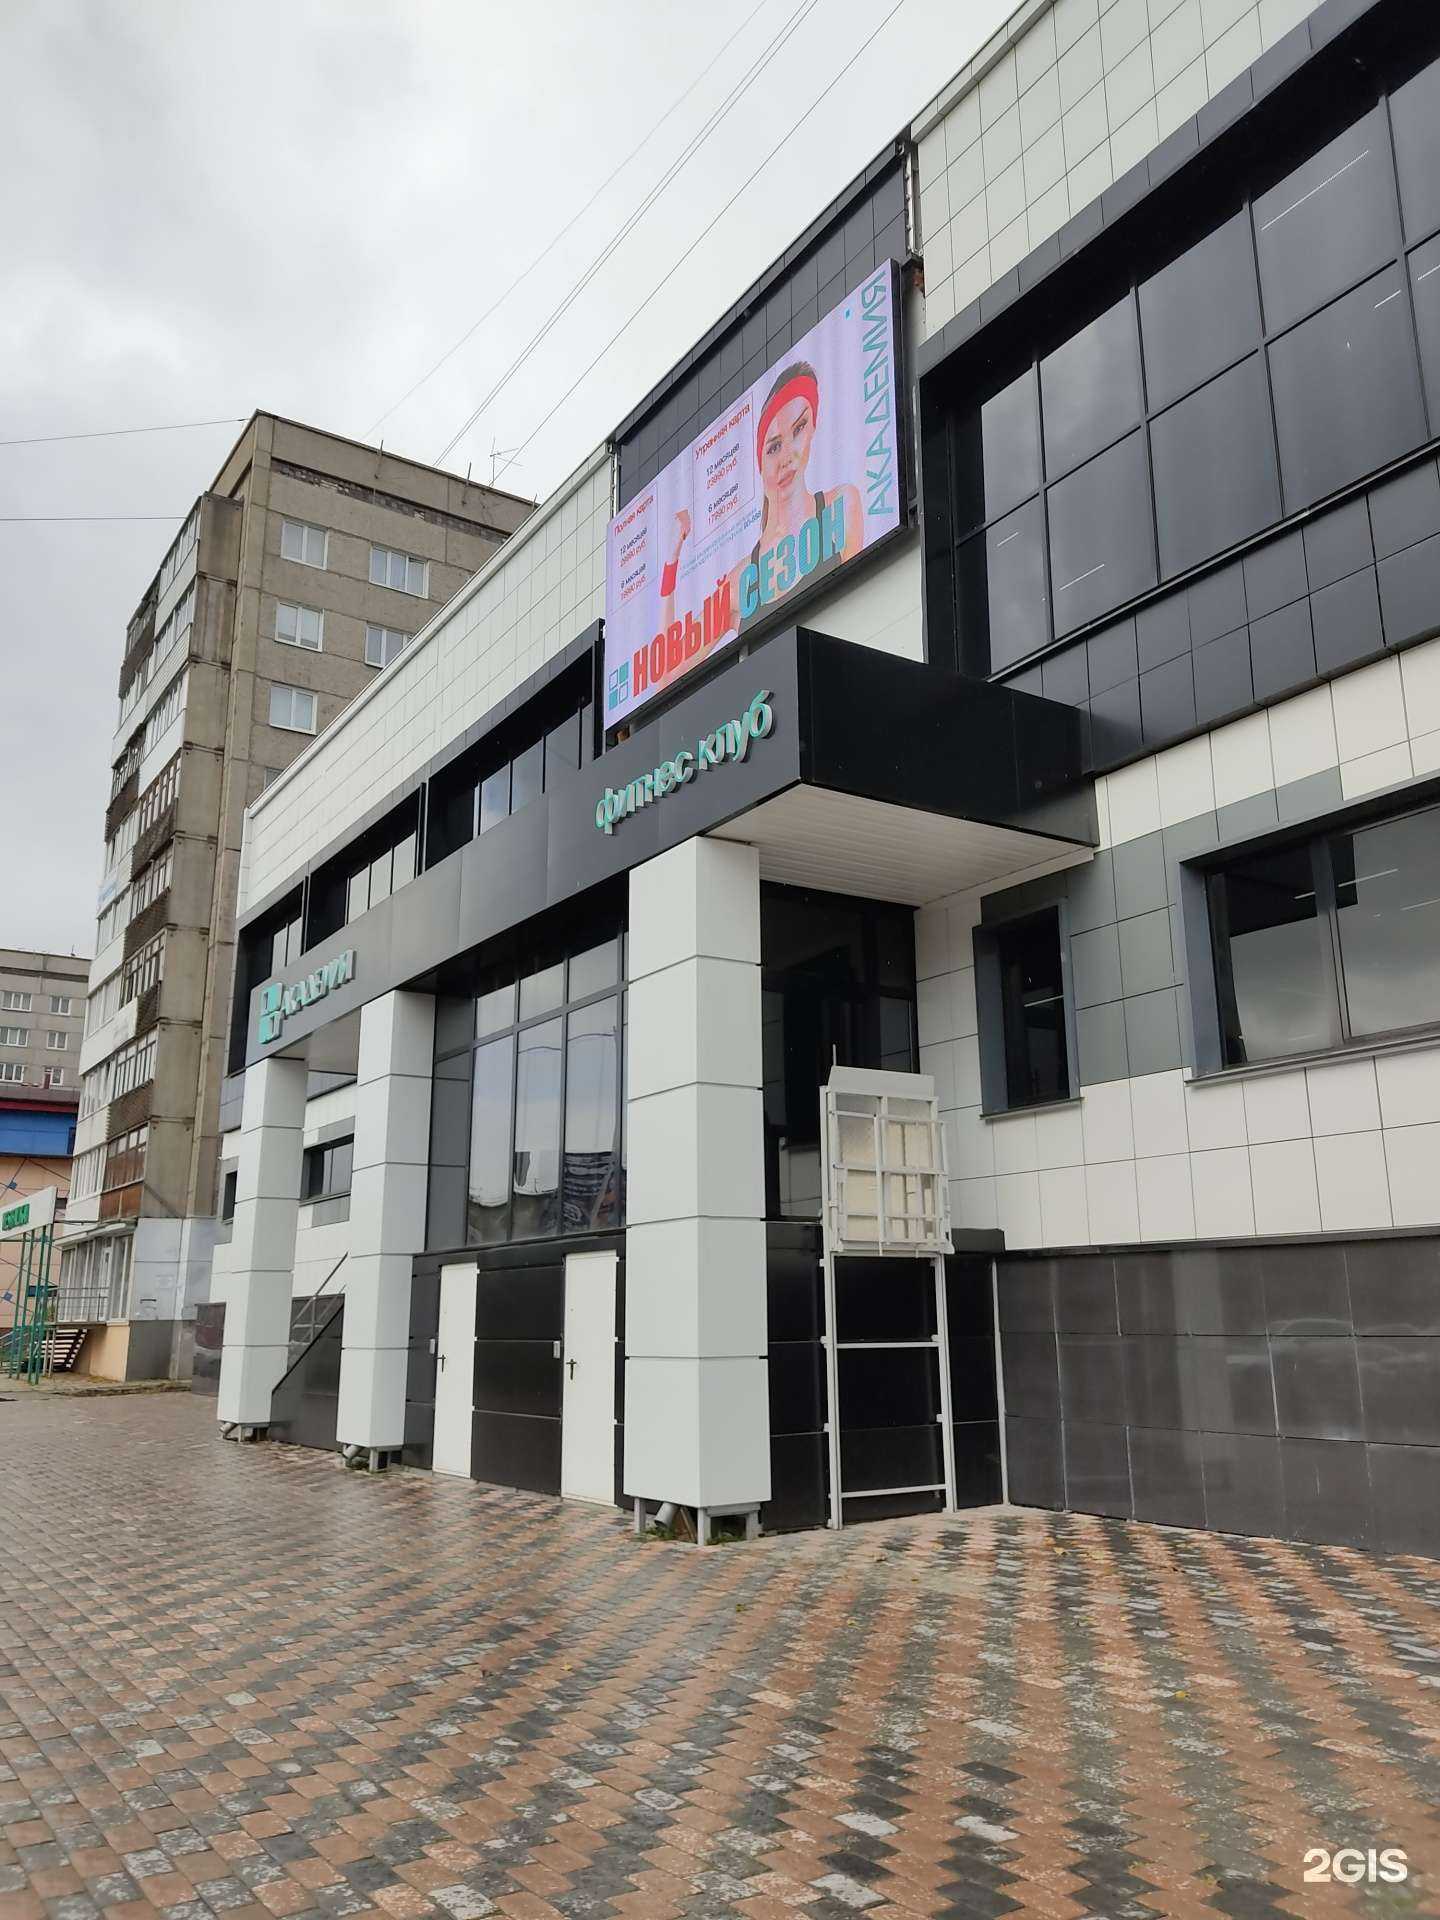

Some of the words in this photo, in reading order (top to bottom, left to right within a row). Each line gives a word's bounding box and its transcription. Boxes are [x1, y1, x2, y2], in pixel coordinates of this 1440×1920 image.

[728, 404, 751, 432] карта
[861, 270, 894, 517] АКАДЕМИЯ
[636, 495, 654, 518] карта
[706, 464, 714, 477] 12
[633, 573, 730, 698] НОВЫЙ
[738, 495, 846, 620] СЕЗОН
[595, 751, 695, 835] фитнес
[698, 689, 774, 771] клуб
